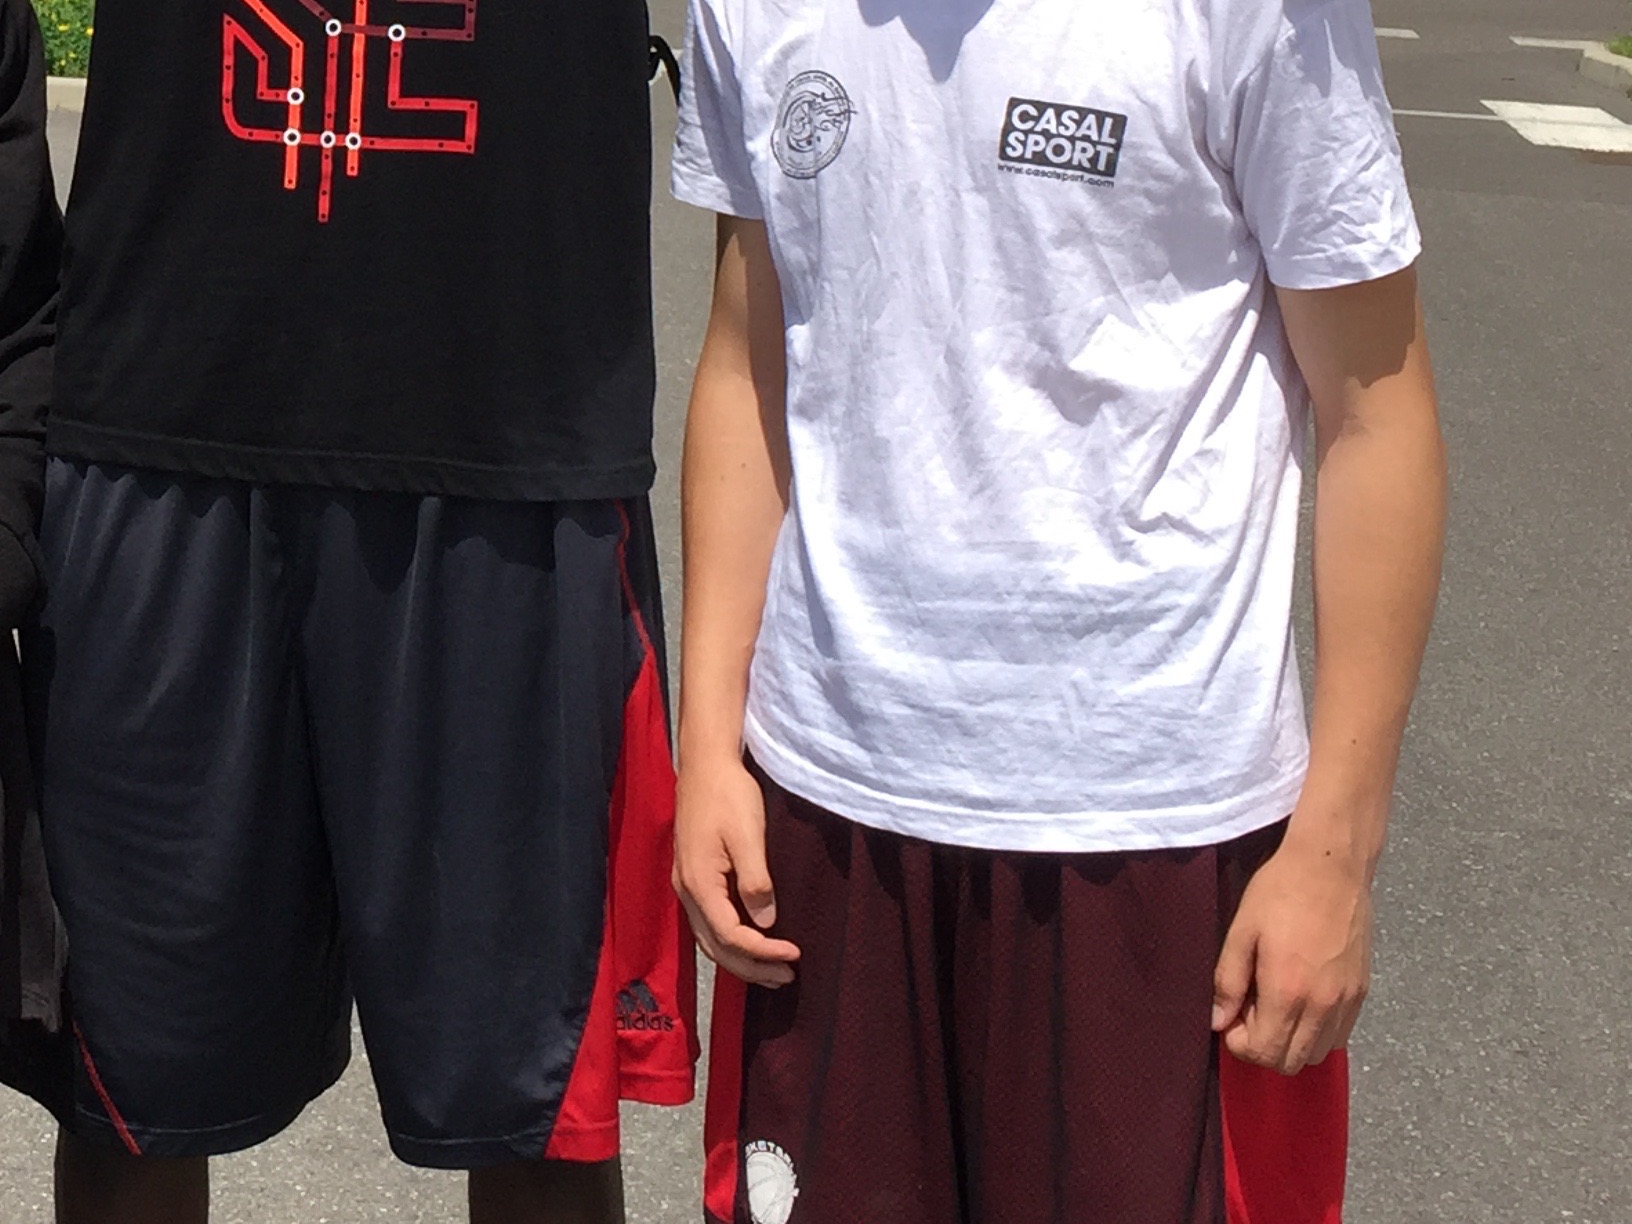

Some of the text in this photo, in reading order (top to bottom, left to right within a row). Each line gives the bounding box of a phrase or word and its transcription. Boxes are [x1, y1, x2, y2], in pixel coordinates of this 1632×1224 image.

[1011, 103, 1118, 145] CASAL
[1004, 130, 1115, 172] SPORT
[997, 162, 1116, 189] www.casalsport.com
